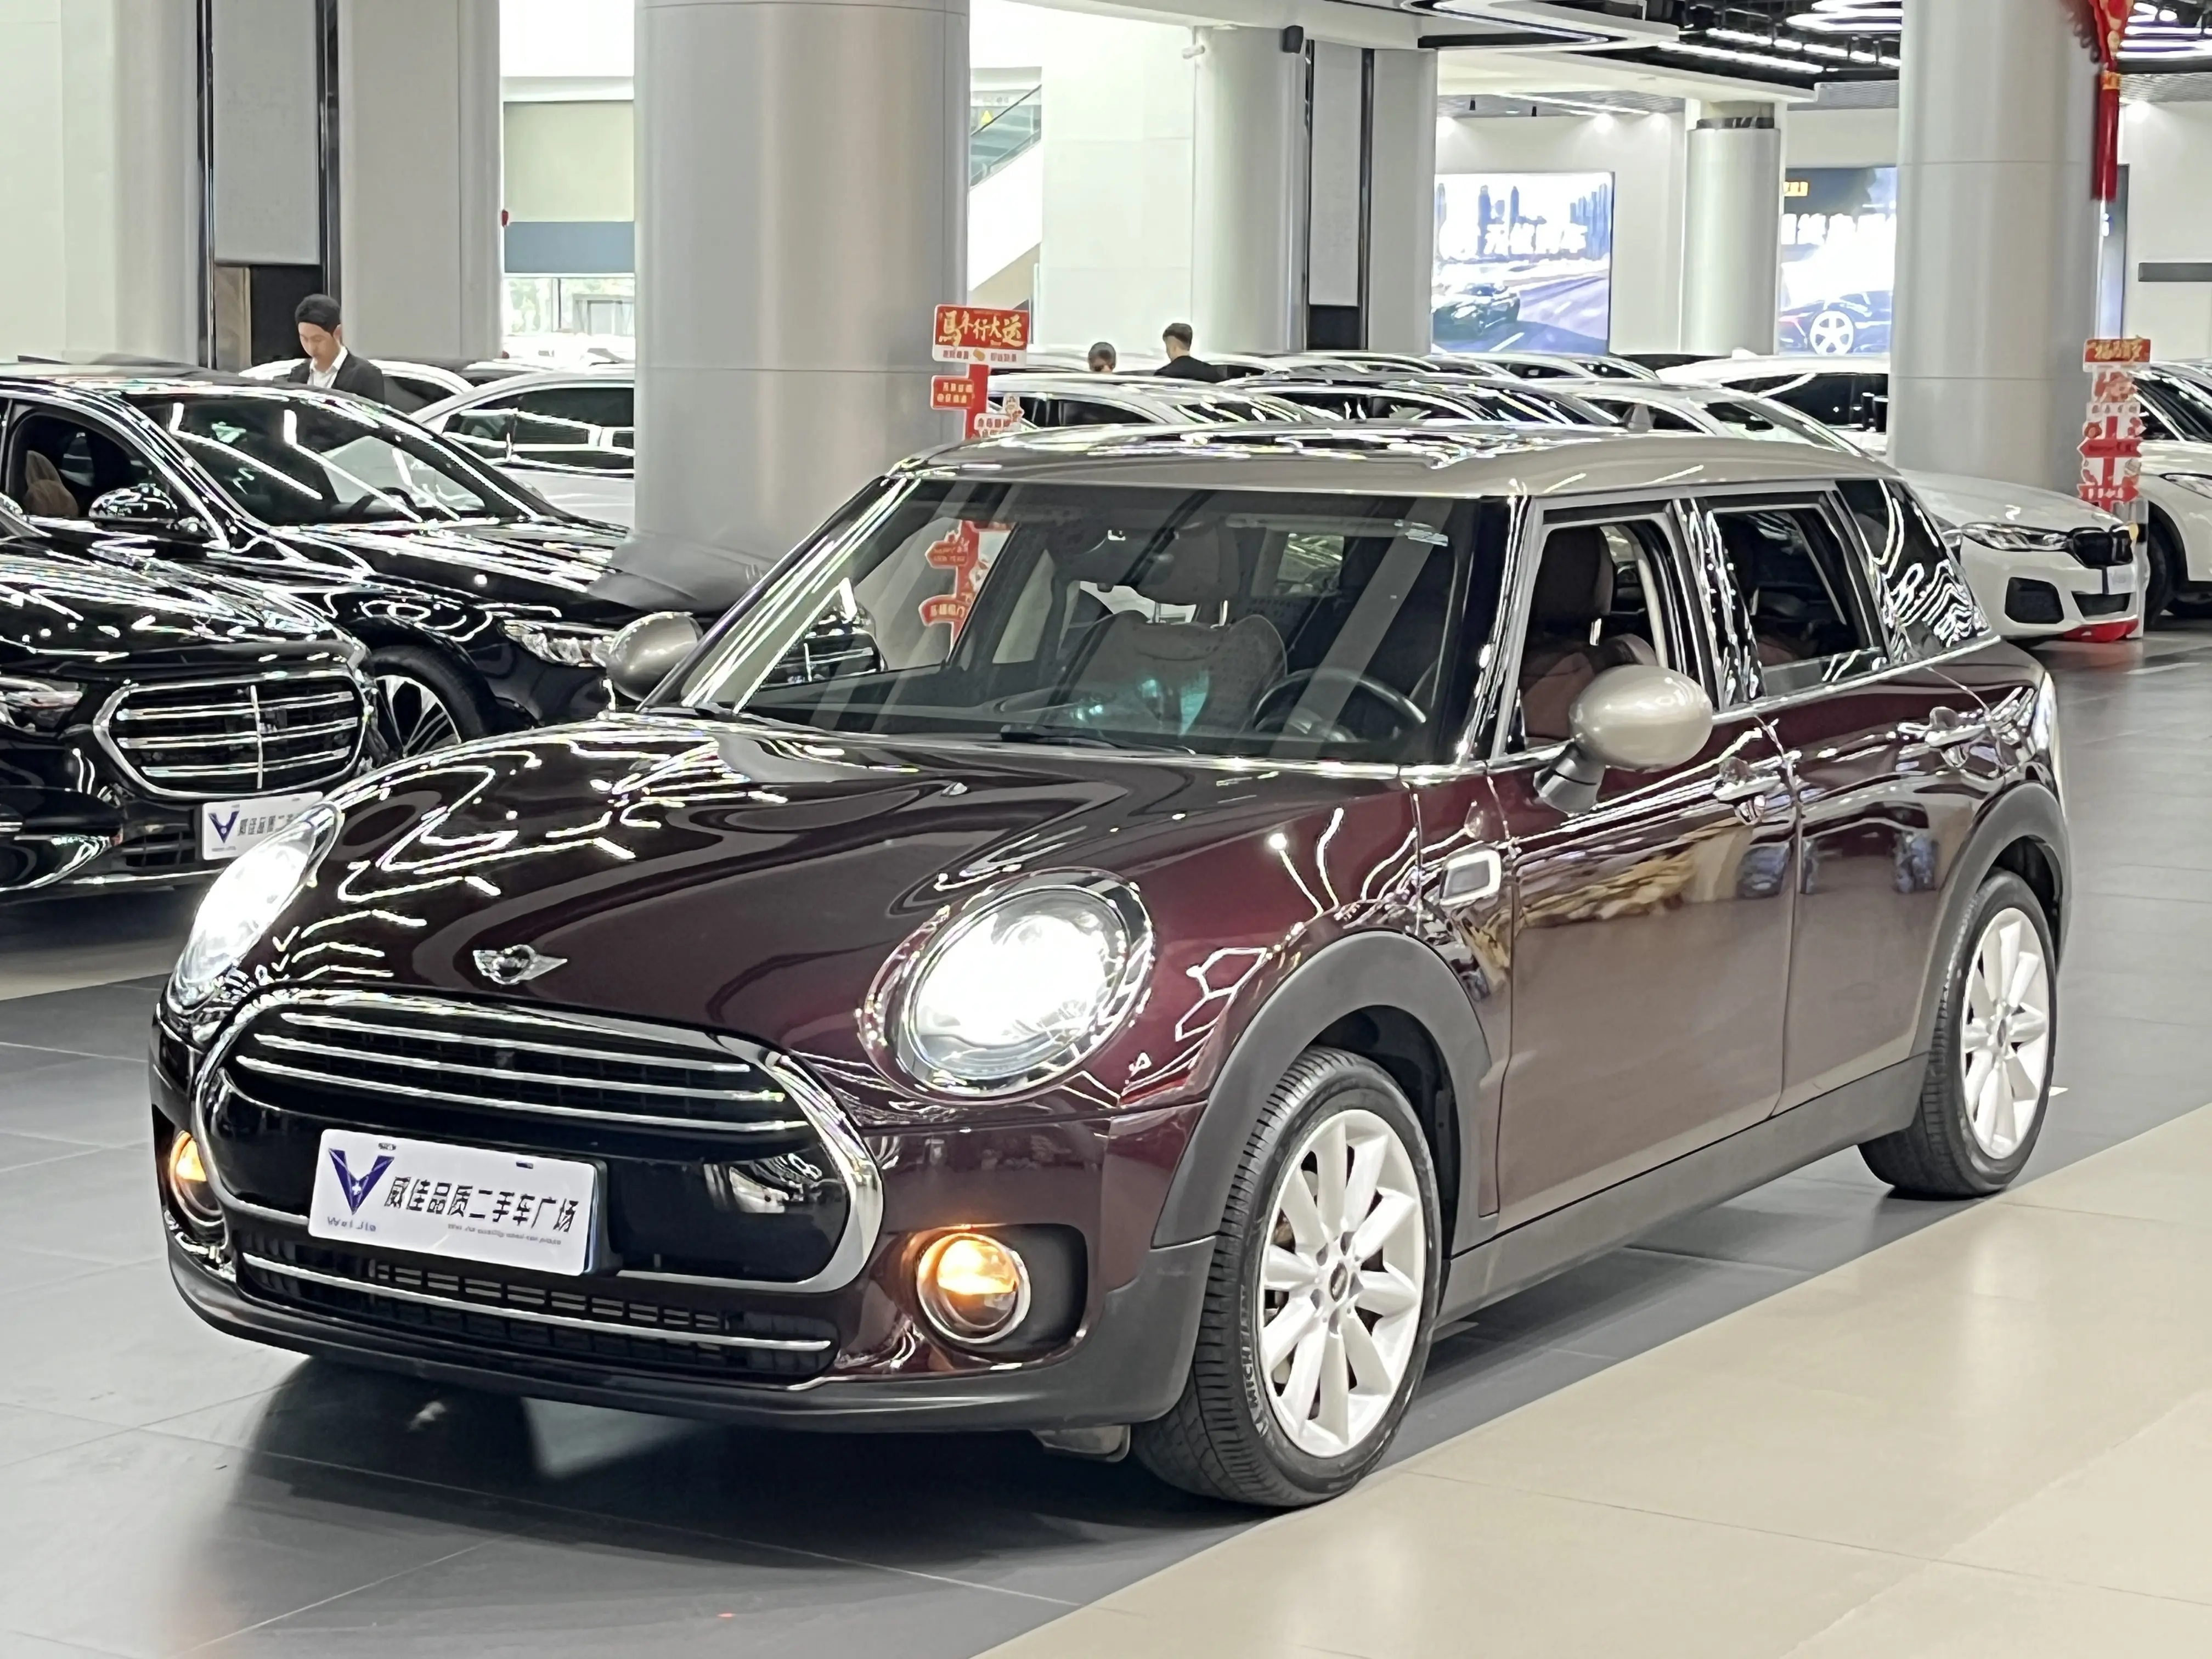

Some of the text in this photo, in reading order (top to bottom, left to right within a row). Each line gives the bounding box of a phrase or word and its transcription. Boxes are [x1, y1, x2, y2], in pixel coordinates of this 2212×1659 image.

[384, 1176, 579, 1233] 威佳品质二手车广场
